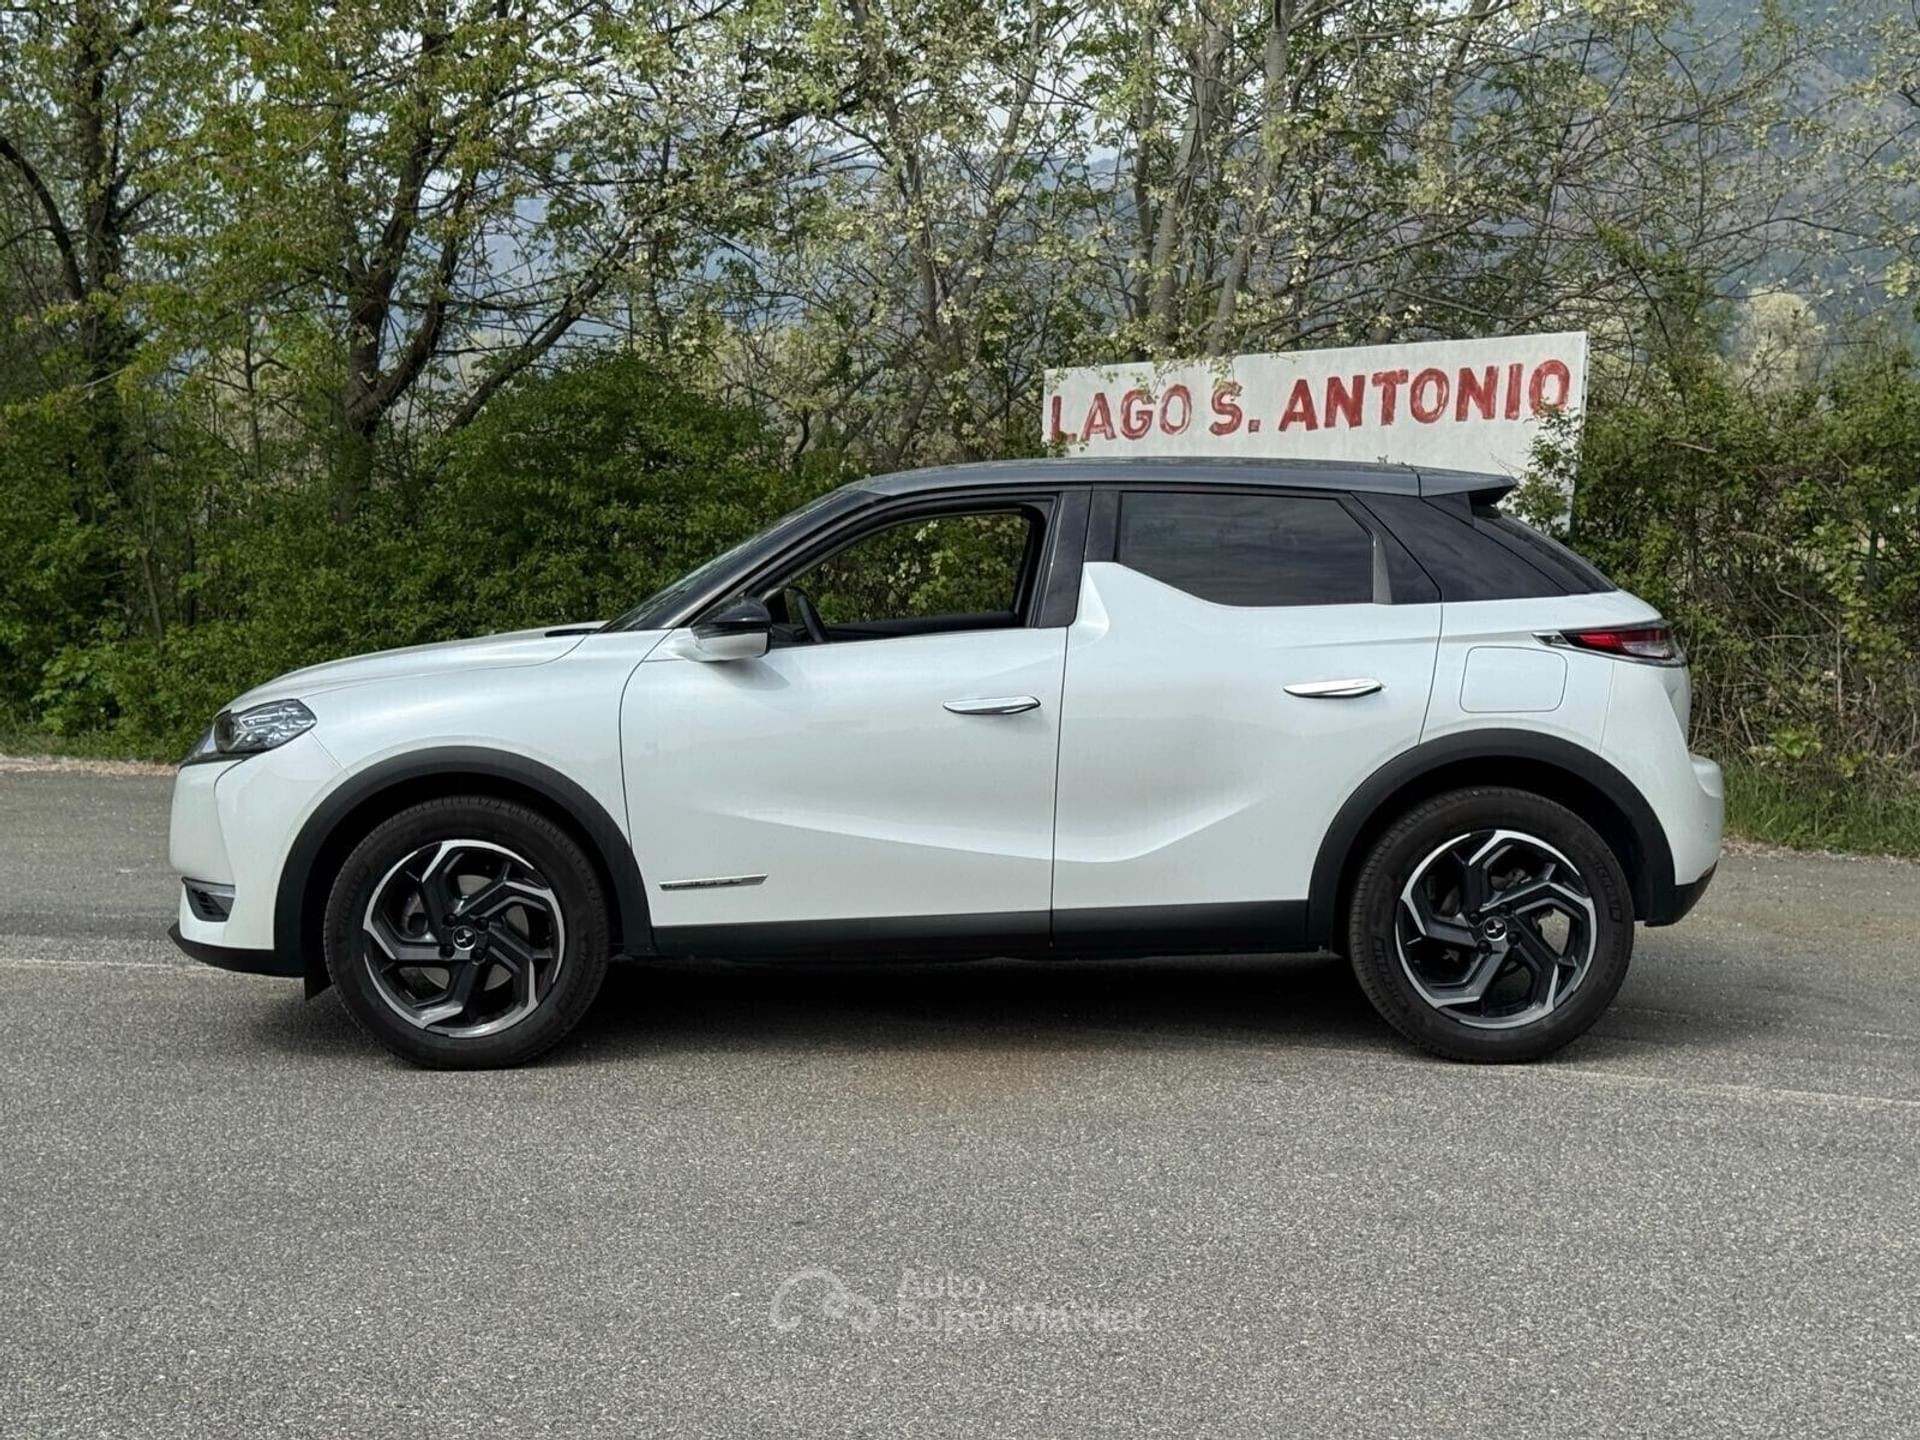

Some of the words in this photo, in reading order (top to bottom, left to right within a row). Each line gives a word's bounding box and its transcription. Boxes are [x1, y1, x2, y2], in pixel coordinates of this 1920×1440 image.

[1051, 384, 1192, 441] LAGO
[1208, 382, 1261, 436] S.
[1279, 359, 1570, 431] ANTONIO
